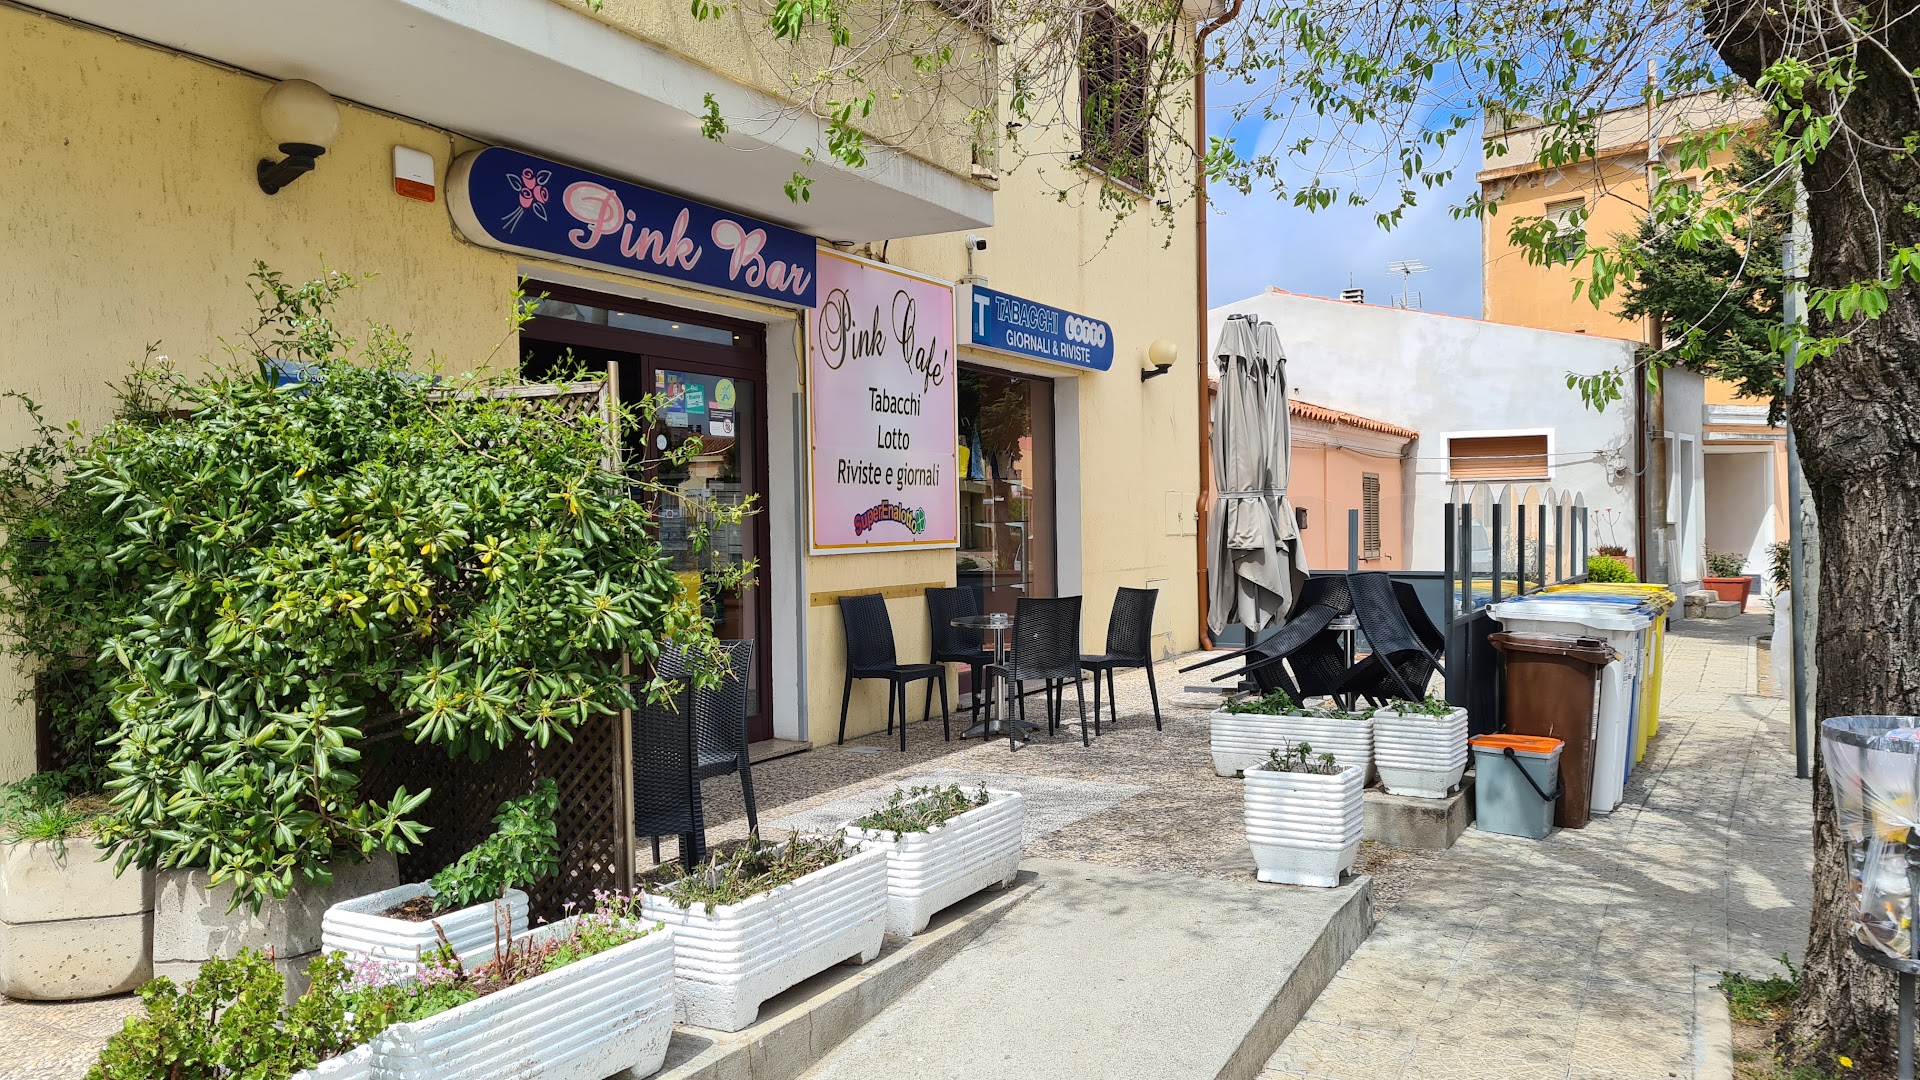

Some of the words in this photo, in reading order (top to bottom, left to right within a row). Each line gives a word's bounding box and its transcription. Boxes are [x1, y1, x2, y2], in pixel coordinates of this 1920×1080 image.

[563, 181, 702, 271] Pink
[711, 219, 811, 295] Bar
[819, 288, 886, 370] Pink
[974, 293, 990, 336] T
[995, 295, 1059, 335] TABACCHI
[1066, 317, 1105, 346] LOTTO
[1006, 329, 1050, 350] GIORNALI
[1053, 340, 1058, 356] &
[1061, 342, 1091, 363] RIVISTE
[869, 387, 921, 416] Tabacchi
[877, 425, 910, 450] Lotto
[837, 459, 882, 485] Riviste
[885, 469, 893, 485] e
[896, 463, 940, 491] giornali
[854, 499, 917, 536] SuperEnalotto
